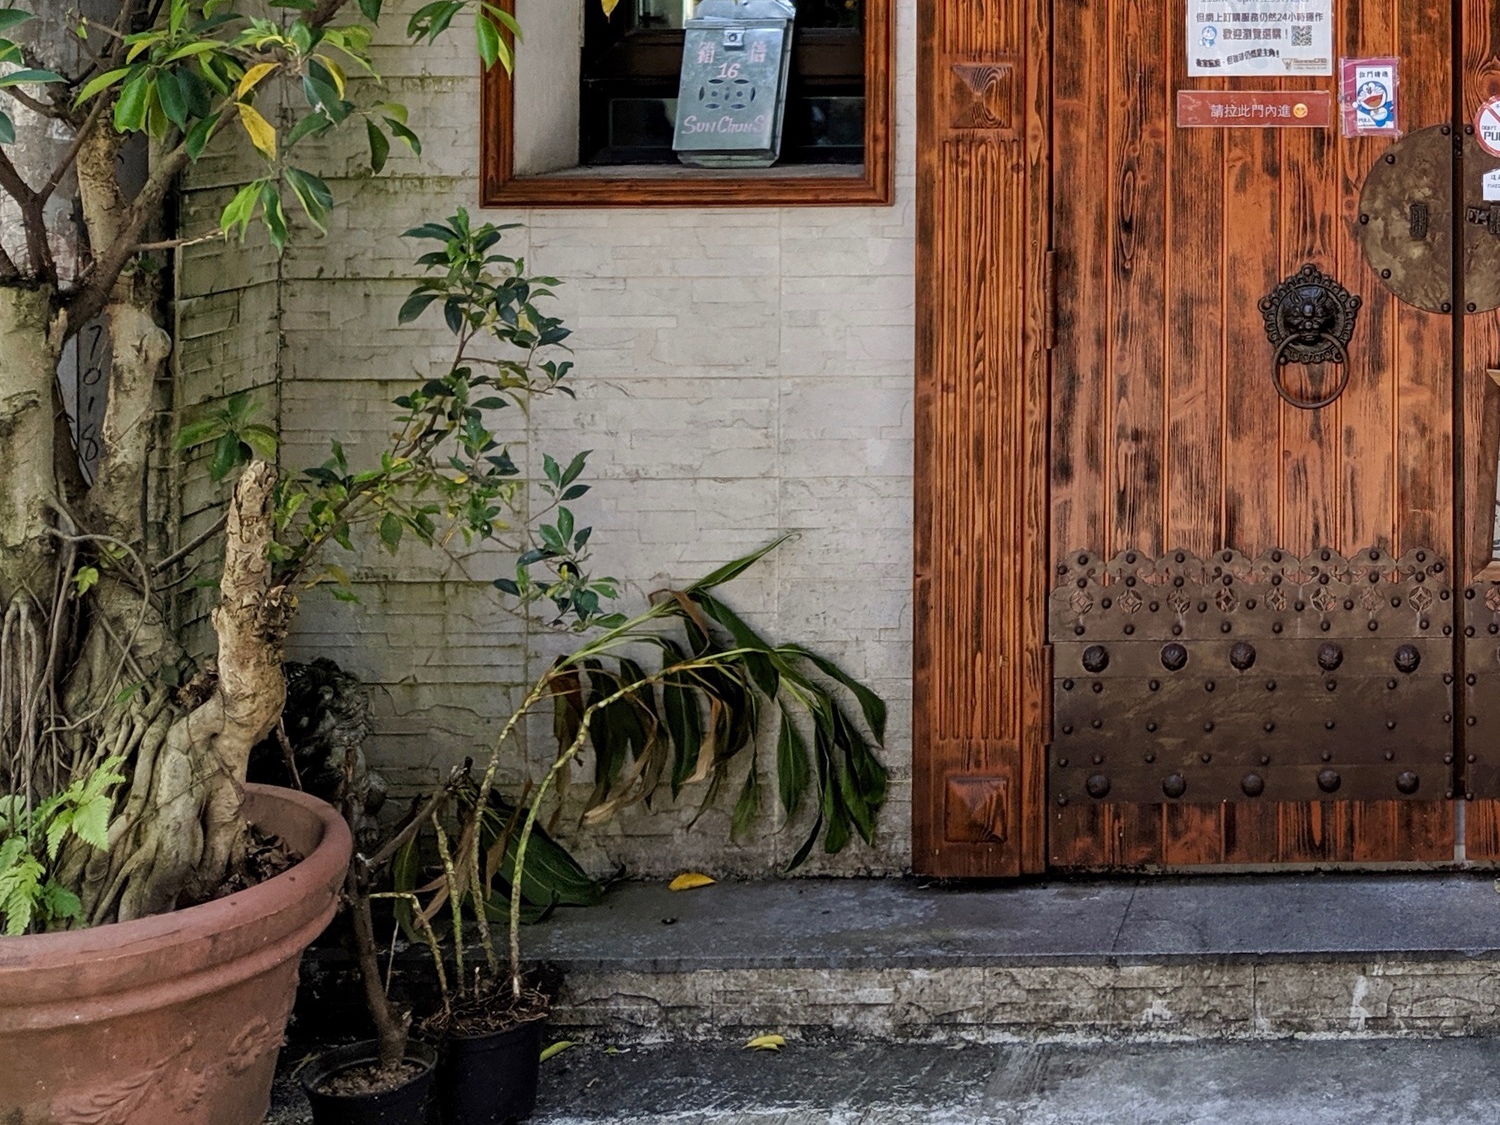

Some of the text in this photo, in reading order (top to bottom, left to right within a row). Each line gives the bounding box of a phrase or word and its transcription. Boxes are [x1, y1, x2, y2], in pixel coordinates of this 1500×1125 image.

[717, 62, 741, 78] 16
[1210, 104, 1291, 118] 請拉此門內進
